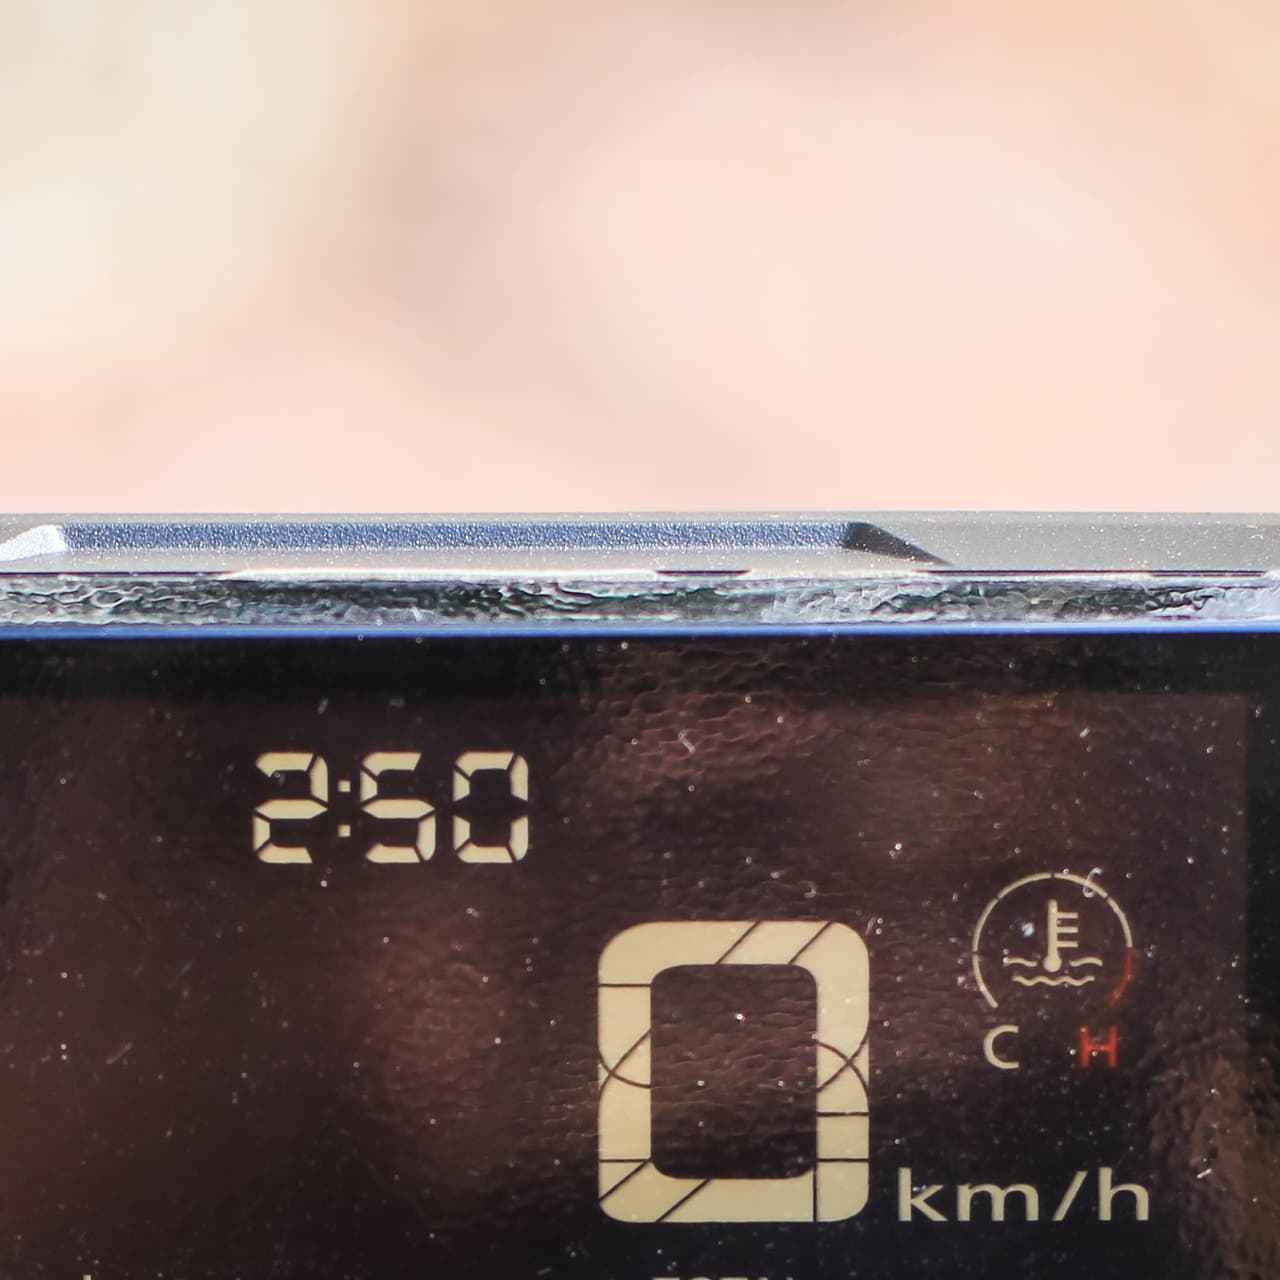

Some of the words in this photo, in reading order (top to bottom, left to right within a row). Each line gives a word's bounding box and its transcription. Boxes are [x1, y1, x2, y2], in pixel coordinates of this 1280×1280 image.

[252, 751, 529, 864] 2:50
[598, 920, 870, 1222] 0
[982, 1025, 1019, 1070] C
[1079, 1026, 1118, 1068] H
[897, 1167, 1150, 1223] km/h
